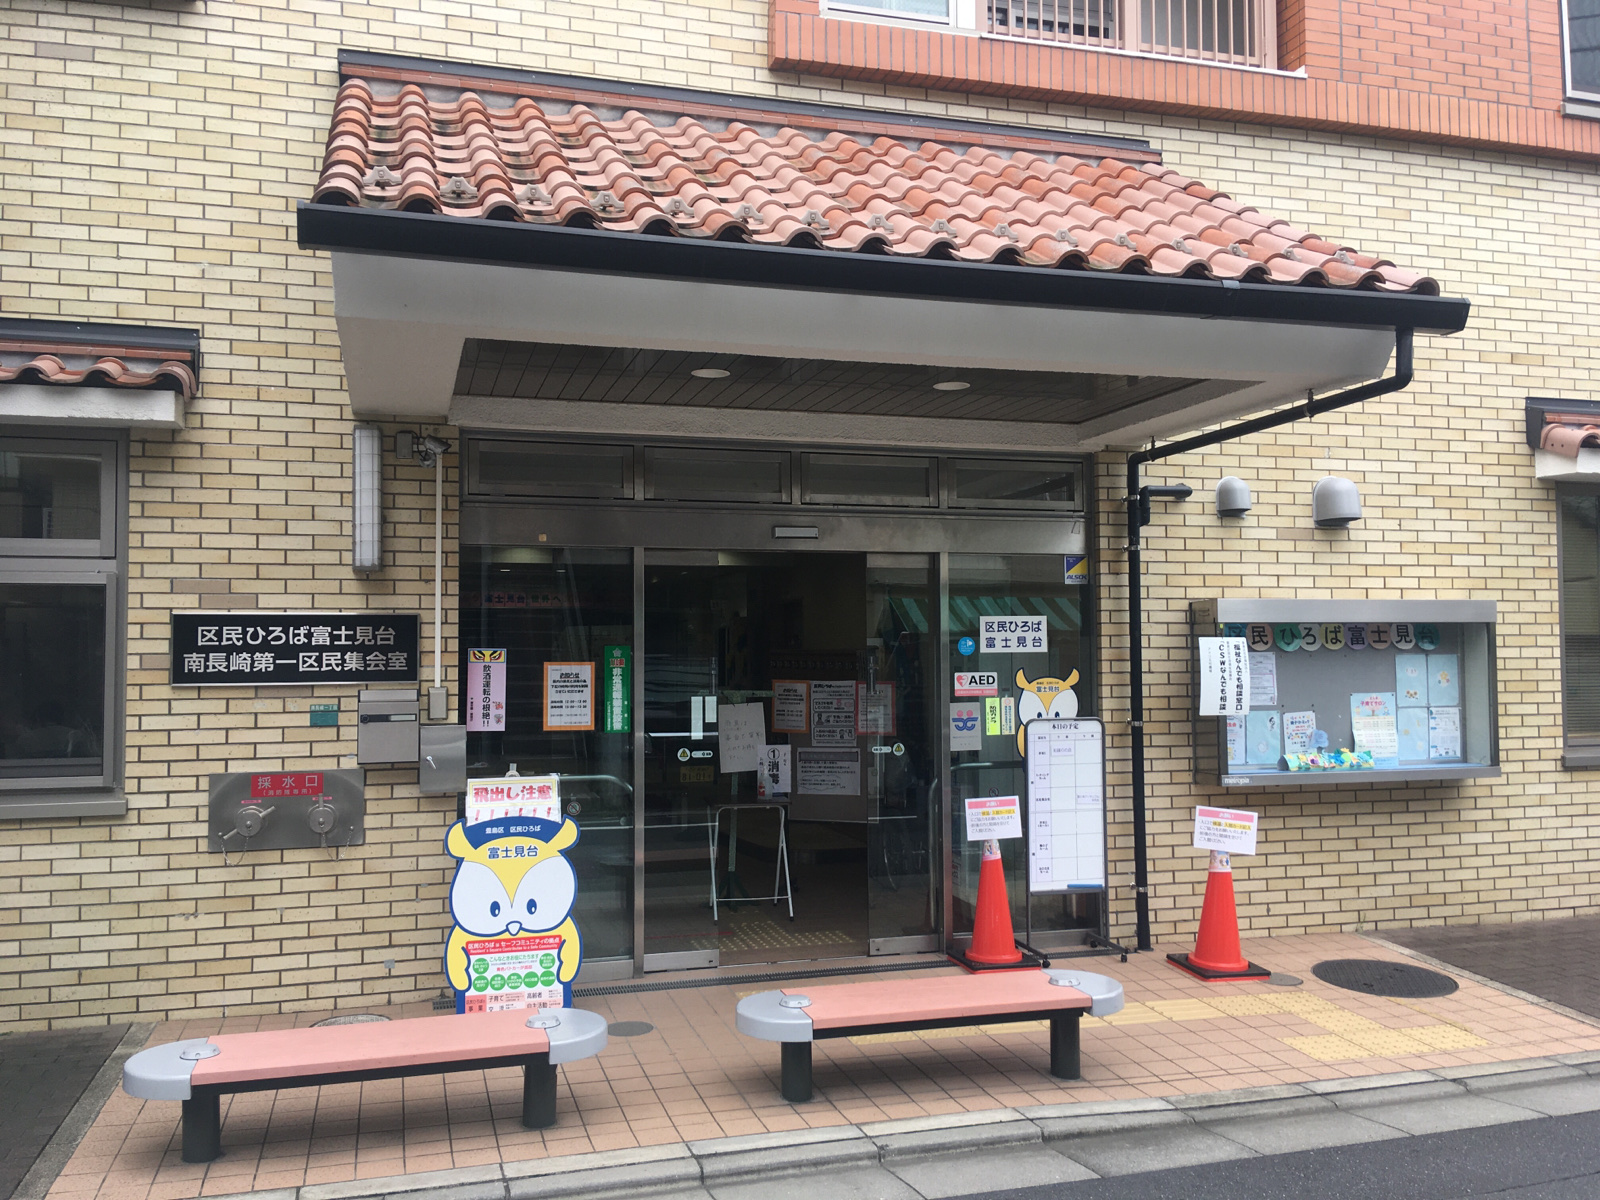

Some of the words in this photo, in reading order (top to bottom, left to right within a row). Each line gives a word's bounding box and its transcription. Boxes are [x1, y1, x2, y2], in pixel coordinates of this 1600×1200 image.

[985, 620, 1042, 633] 区民ひろば
[197, 626, 396, 647] 区民ひろば富士見台
[985, 636, 1043, 648] 富士見台
[183, 651, 408, 673] 南長崎第一区民集会室
[969, 675, 996, 685] AED
[1036, 685, 1060, 693] 富士見台
[1052, 722, 1079, 730] 本日の予定
[473, 784, 552, 803] 飛出し注意
[485, 826, 505, 834] 豊島区
[509, 825, 541, 833] 区民ひろば
[487, 844, 539, 860] 富士見台
[468, 942, 495, 950] 区民ひろば
[488, 995, 504, 1003] 子育て
[526, 991, 543, 999] 高齢者
